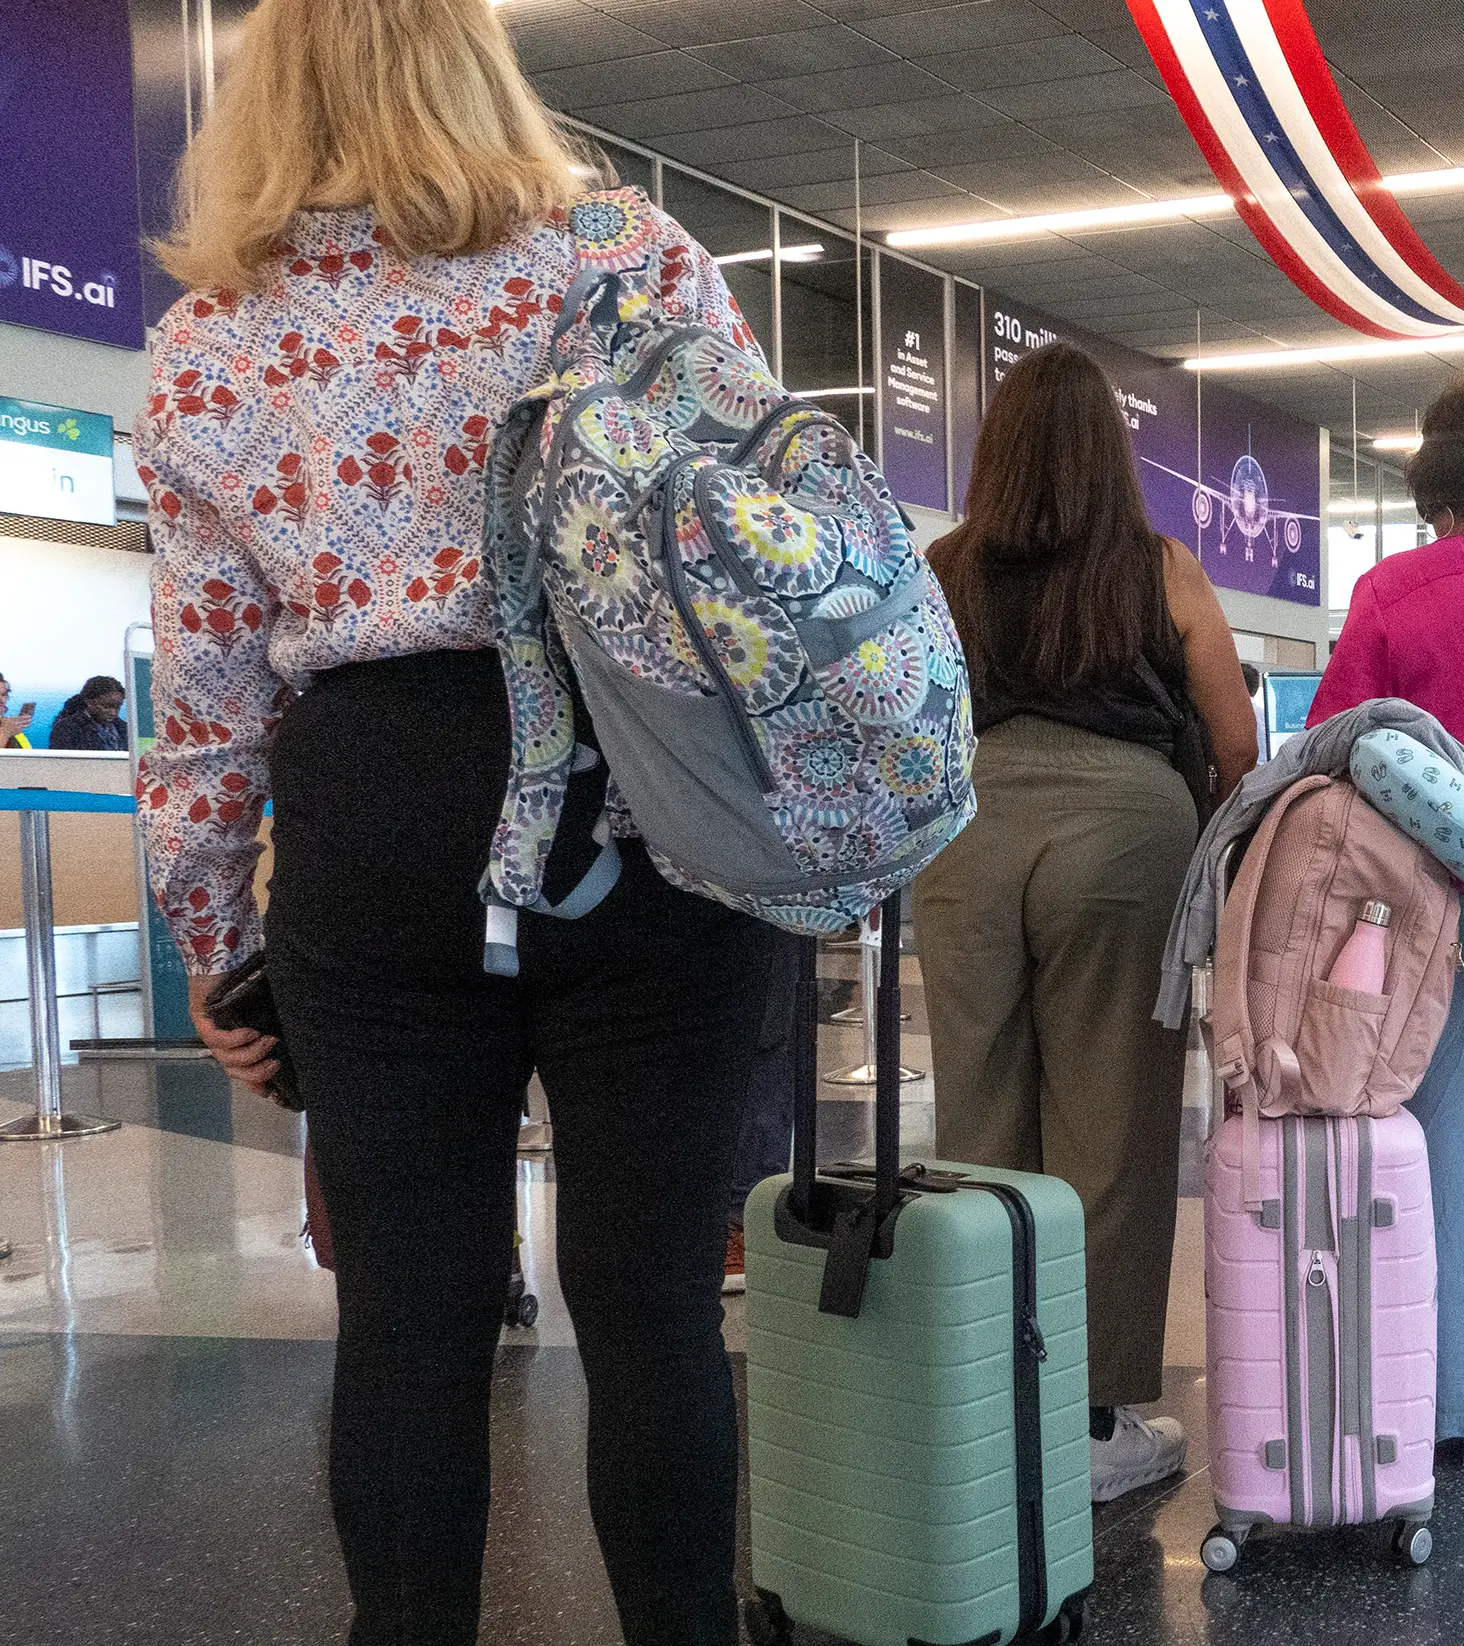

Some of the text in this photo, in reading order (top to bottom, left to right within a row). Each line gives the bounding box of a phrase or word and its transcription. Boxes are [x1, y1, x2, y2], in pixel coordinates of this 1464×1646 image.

[22, 256, 115, 308] IFS.ai
[904, 330, 920, 351] #1
[994, 311, 1058, 349] 310 mill
[897, 348, 928, 368] in Asset
[994, 346, 1020, 364] pass
[890, 364, 935, 386] and Service
[887, 376, 938, 402] Management
[896, 396, 931, 414] software
[1128, 393, 1158, 415] thanks
[0, 414, 51, 436] ngus
[1121, 411, 1140, 430] S.ai
[1296, 572, 1315, 590] IFS.ai
